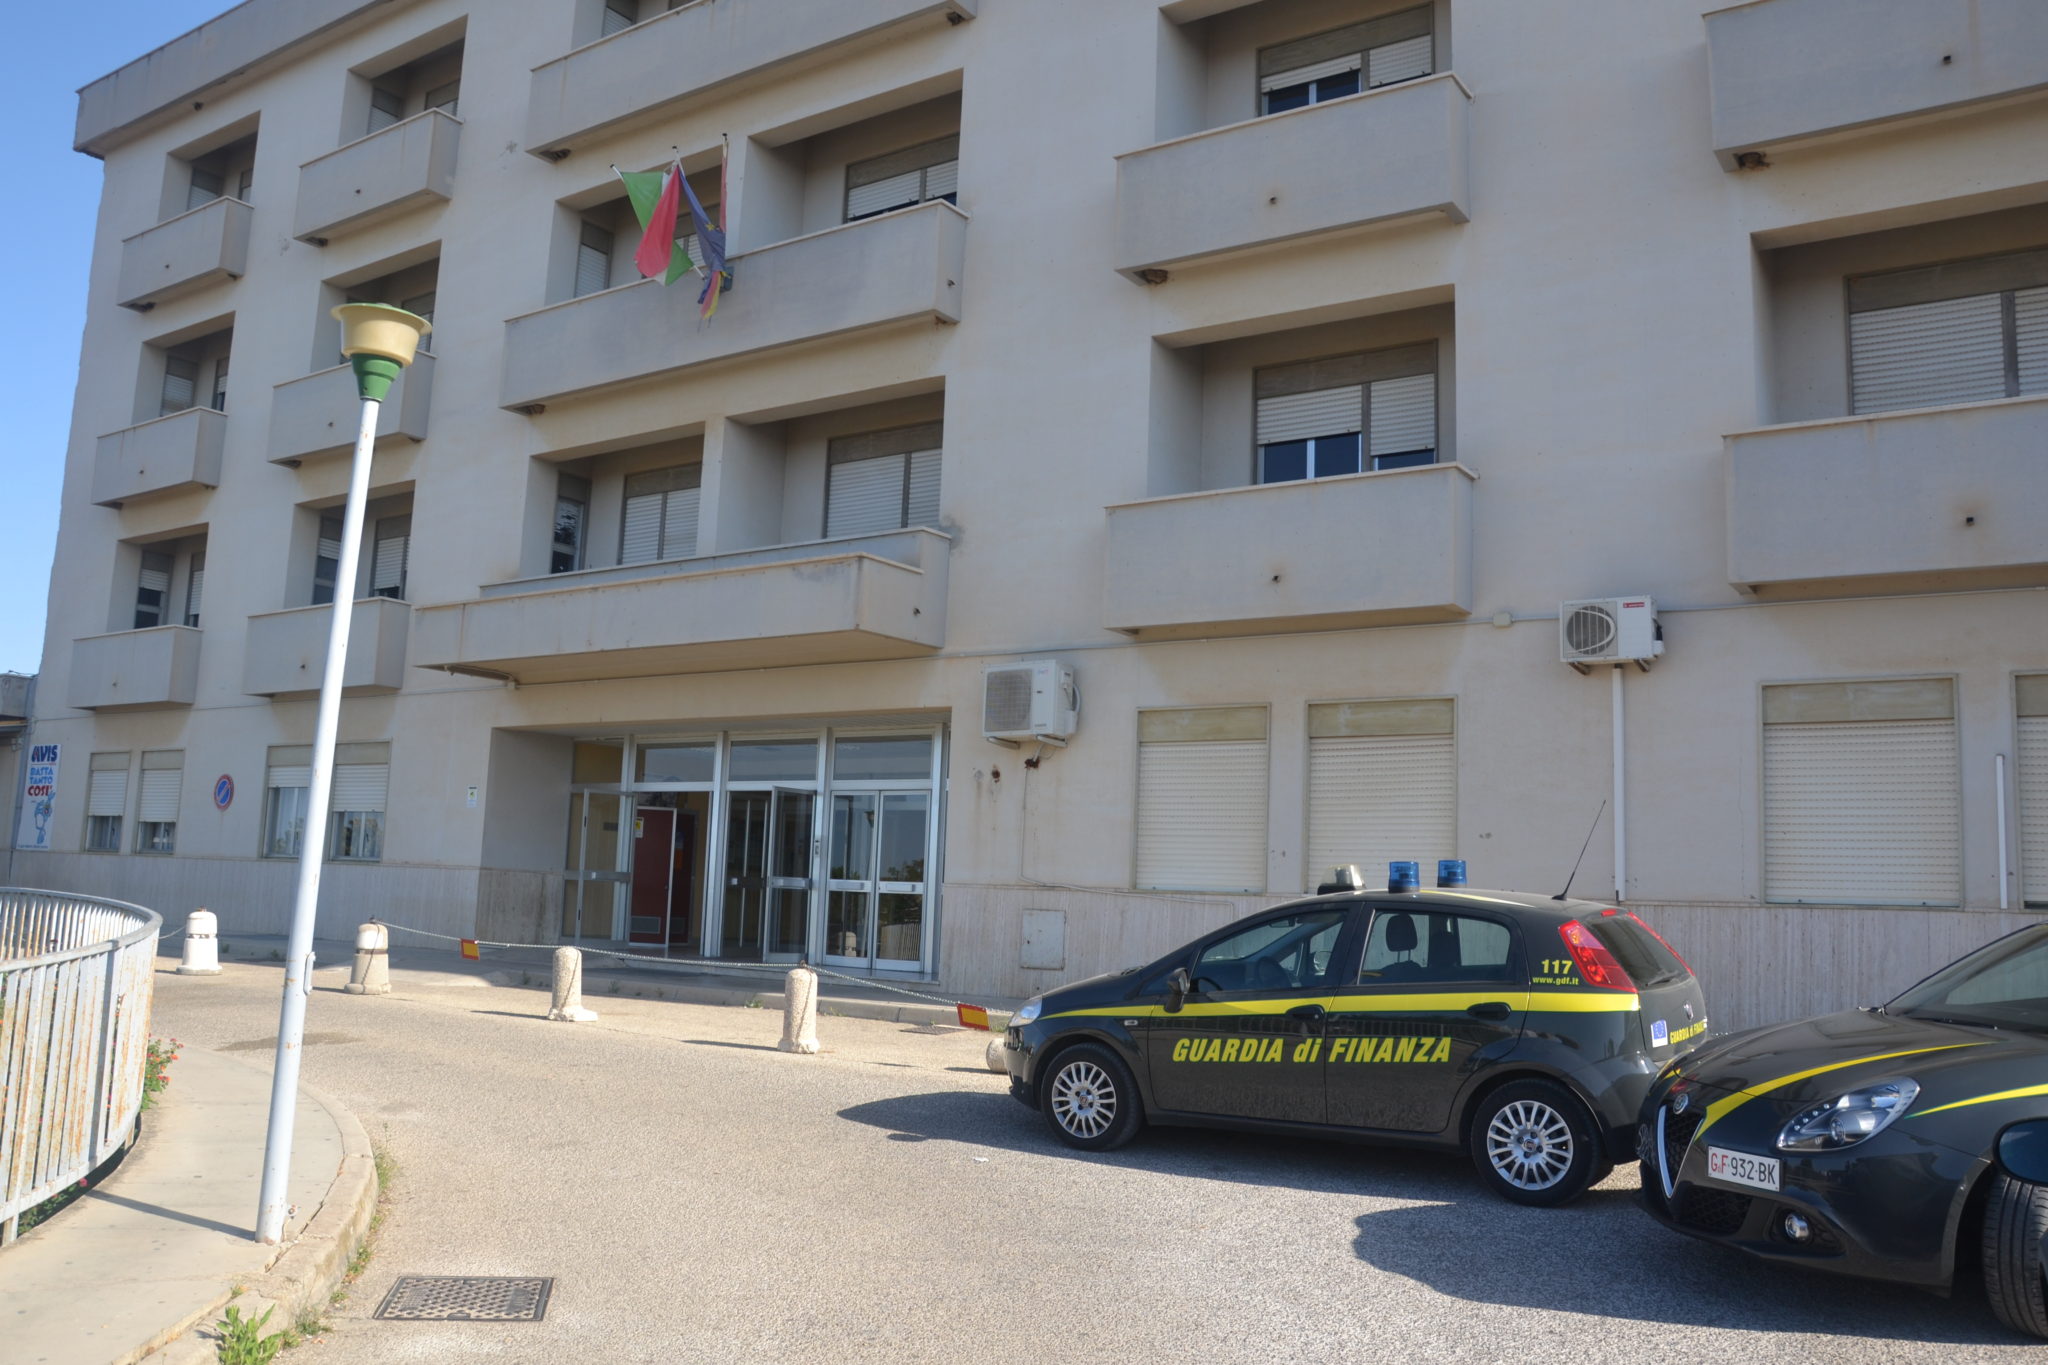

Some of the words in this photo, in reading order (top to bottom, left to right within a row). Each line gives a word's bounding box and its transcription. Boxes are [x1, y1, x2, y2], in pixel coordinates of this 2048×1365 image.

[31, 745, 58, 763] AVIS
[1541, 959, 1573, 975] 117
[1532, 976, 1579, 986] www.gdf.it
[1172, 1038, 1284, 1063] GUARDIA
[1293, 1038, 1323, 1063] di
[1328, 1037, 1452, 1063] FINANZA
